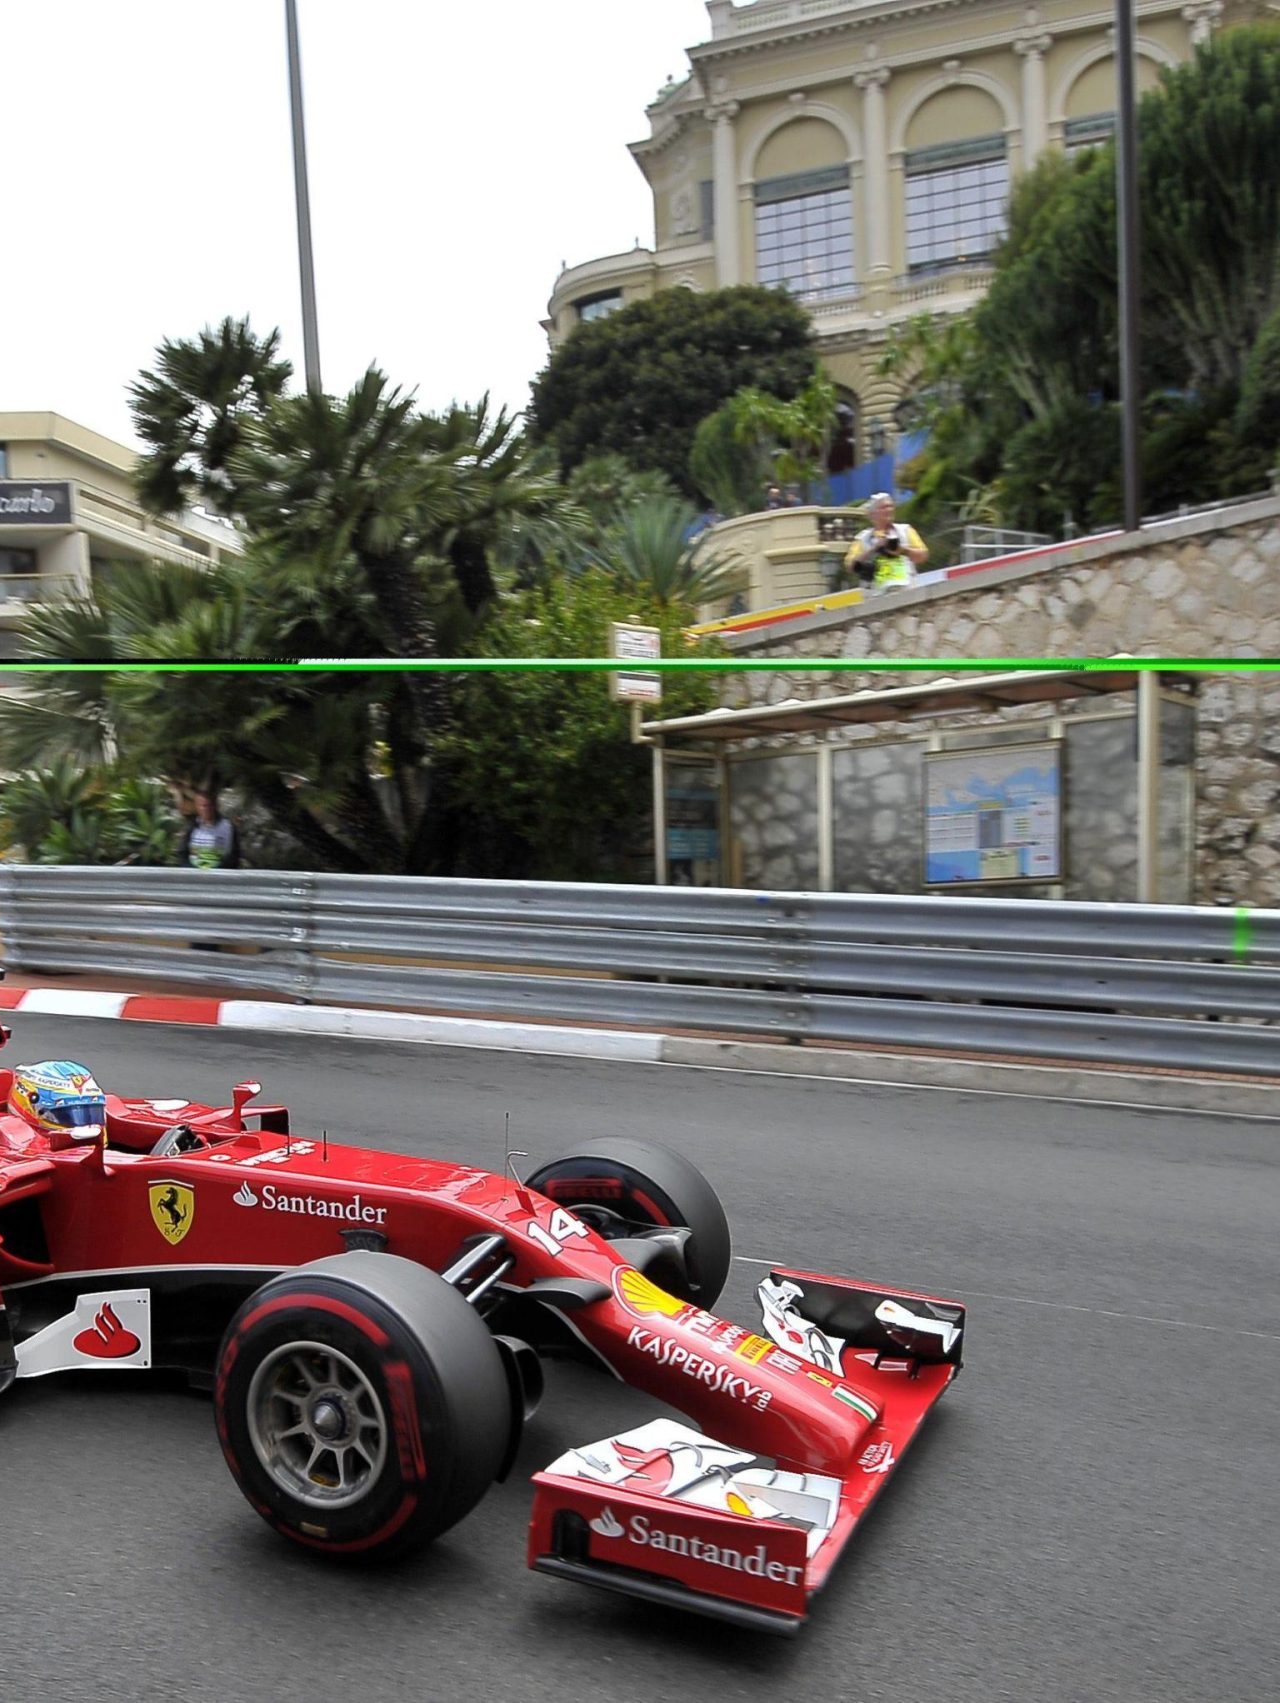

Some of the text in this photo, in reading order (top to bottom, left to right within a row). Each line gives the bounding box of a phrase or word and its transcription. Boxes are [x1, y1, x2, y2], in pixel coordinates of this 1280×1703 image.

[262, 1185, 387, 1224] Santander
[527, 1207, 590, 1256] 14
[627, 1325, 762, 1404] KASPERSKY
[752, 1390, 773, 1412] lab
[628, 1515, 804, 1586] Santander
